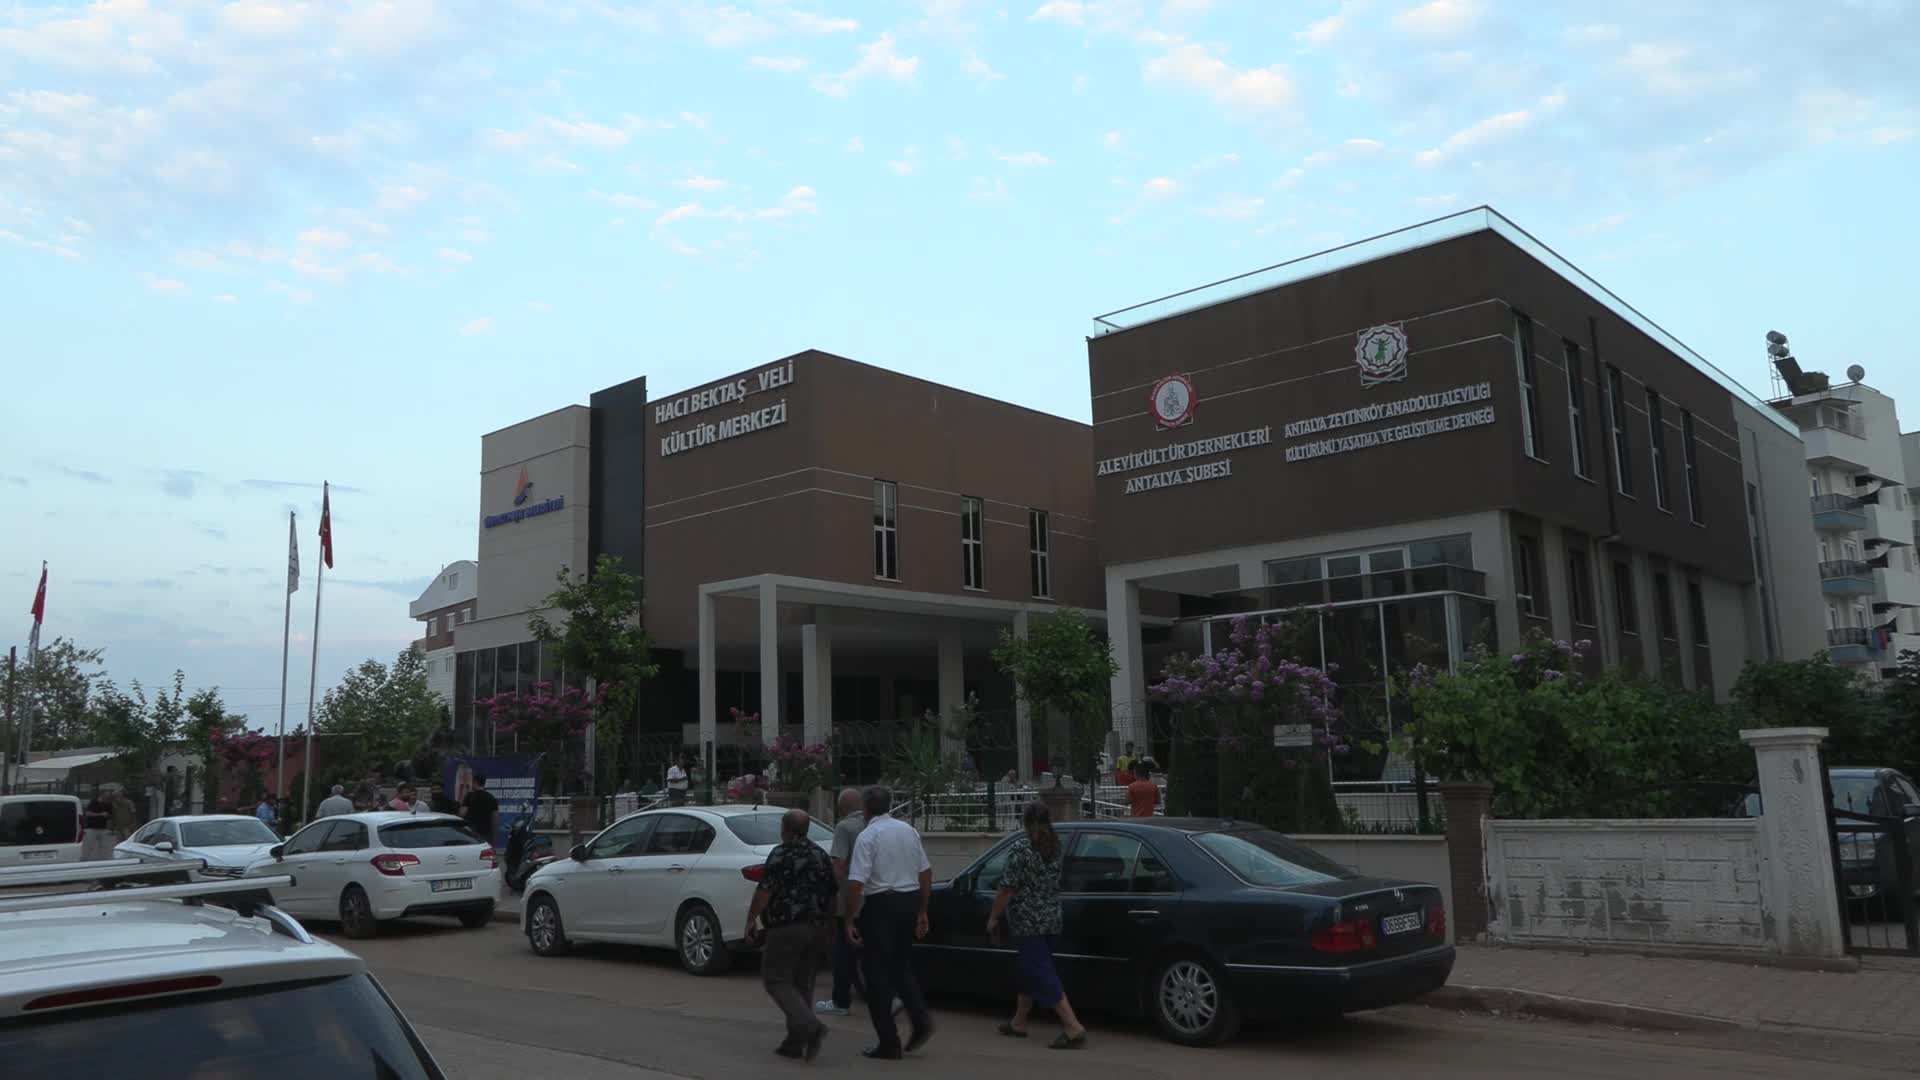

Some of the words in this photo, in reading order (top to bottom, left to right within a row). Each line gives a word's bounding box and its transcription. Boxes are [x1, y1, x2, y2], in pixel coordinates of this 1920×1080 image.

[655, 396, 689, 424] HACI
[690, 378, 746, 412] BEKTAŞ
[758, 359, 794, 391] VELİ
[661, 423, 716, 457] KÜLTÜR
[718, 399, 787, 440] MERKEZİ
[1284, 415, 1327, 438] ANTALYA
[1385, 395, 1440, 418] ANADOLU
[1381, 429, 1394, 443] VE
[1134, 443, 1185, 468] KÜLTÜR
[1187, 425, 1271, 457] DERNEKLERİ
[1125, 471, 1184, 494] ANTALYA
[1186, 458, 1231, 484] ŞUBESİ
